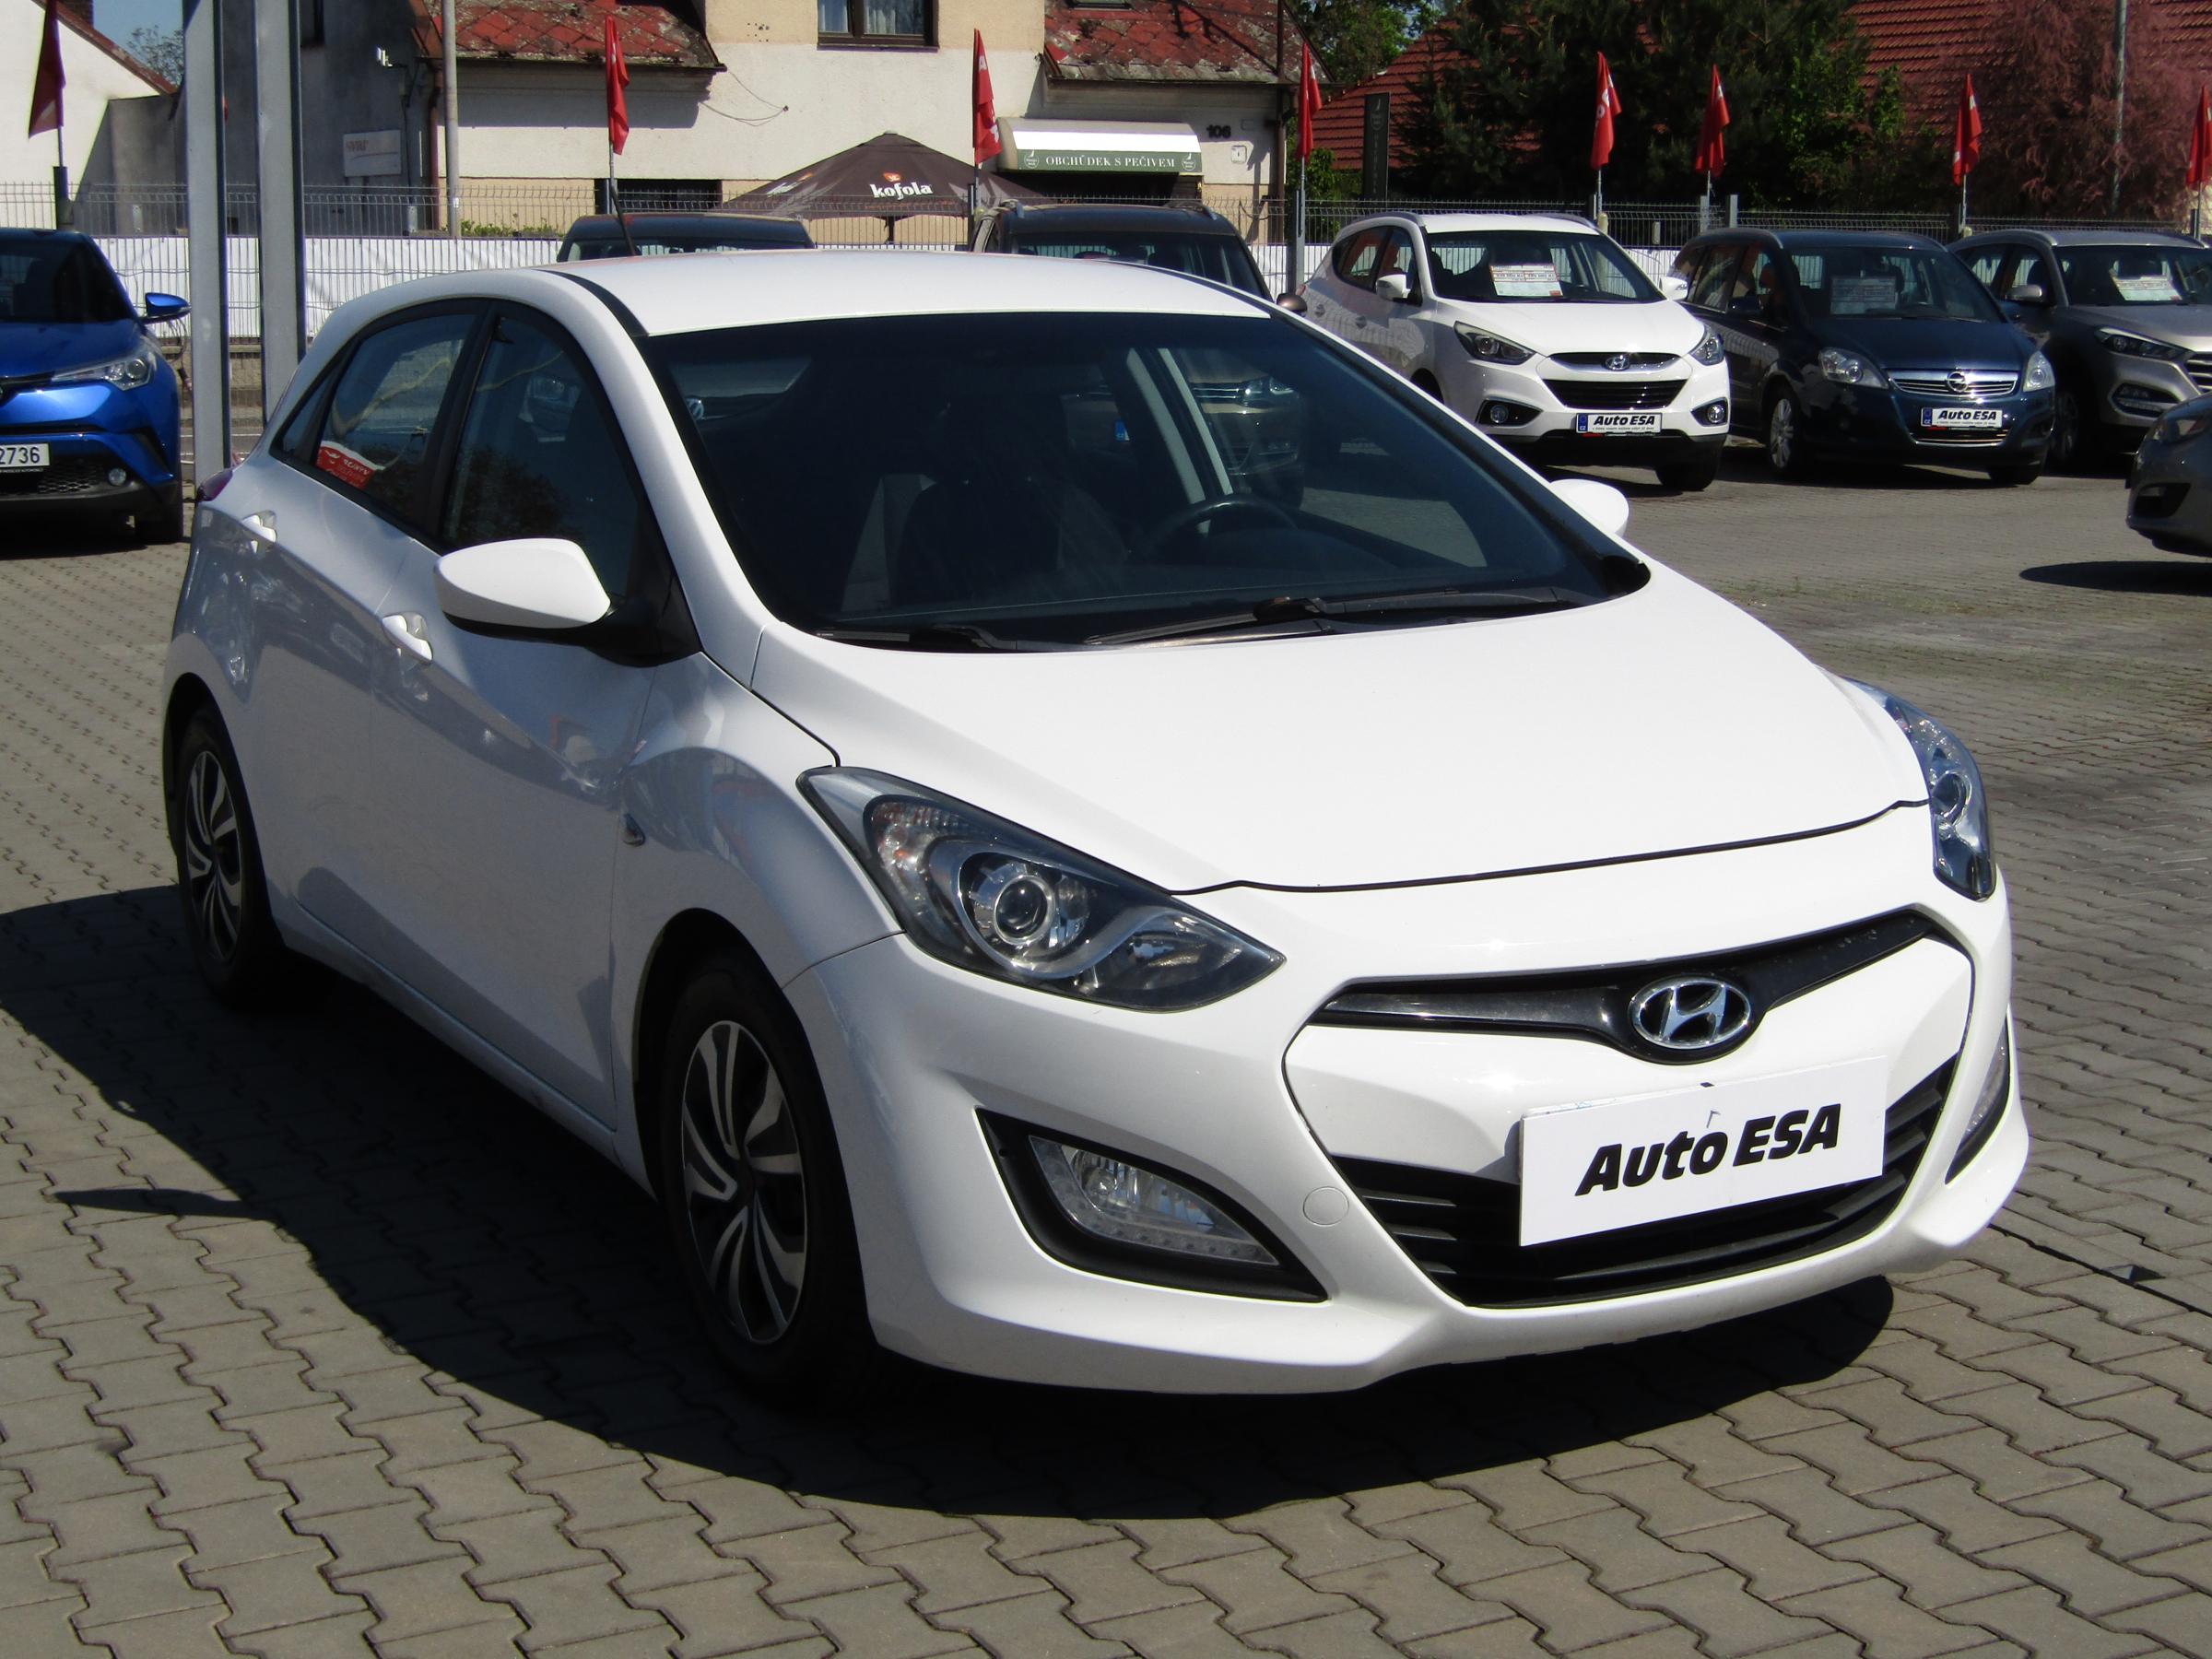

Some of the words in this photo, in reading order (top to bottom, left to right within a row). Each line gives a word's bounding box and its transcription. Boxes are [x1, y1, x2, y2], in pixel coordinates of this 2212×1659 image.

[1206, 124, 1231, 138] 106
[1114, 158, 1122, 167] S
[1124, 156, 1175, 168] PEČIVEM
[869, 182, 934, 200] kofola
[1594, 416, 1629, 426] Auto
[1630, 416, 1655, 426] ESA
[1938, 410, 1971, 420] Auto
[1972, 411, 1996, 420] ESA
[1574, 1130, 1729, 1197] Auto
[1732, 1102, 1841, 1168] ESA
